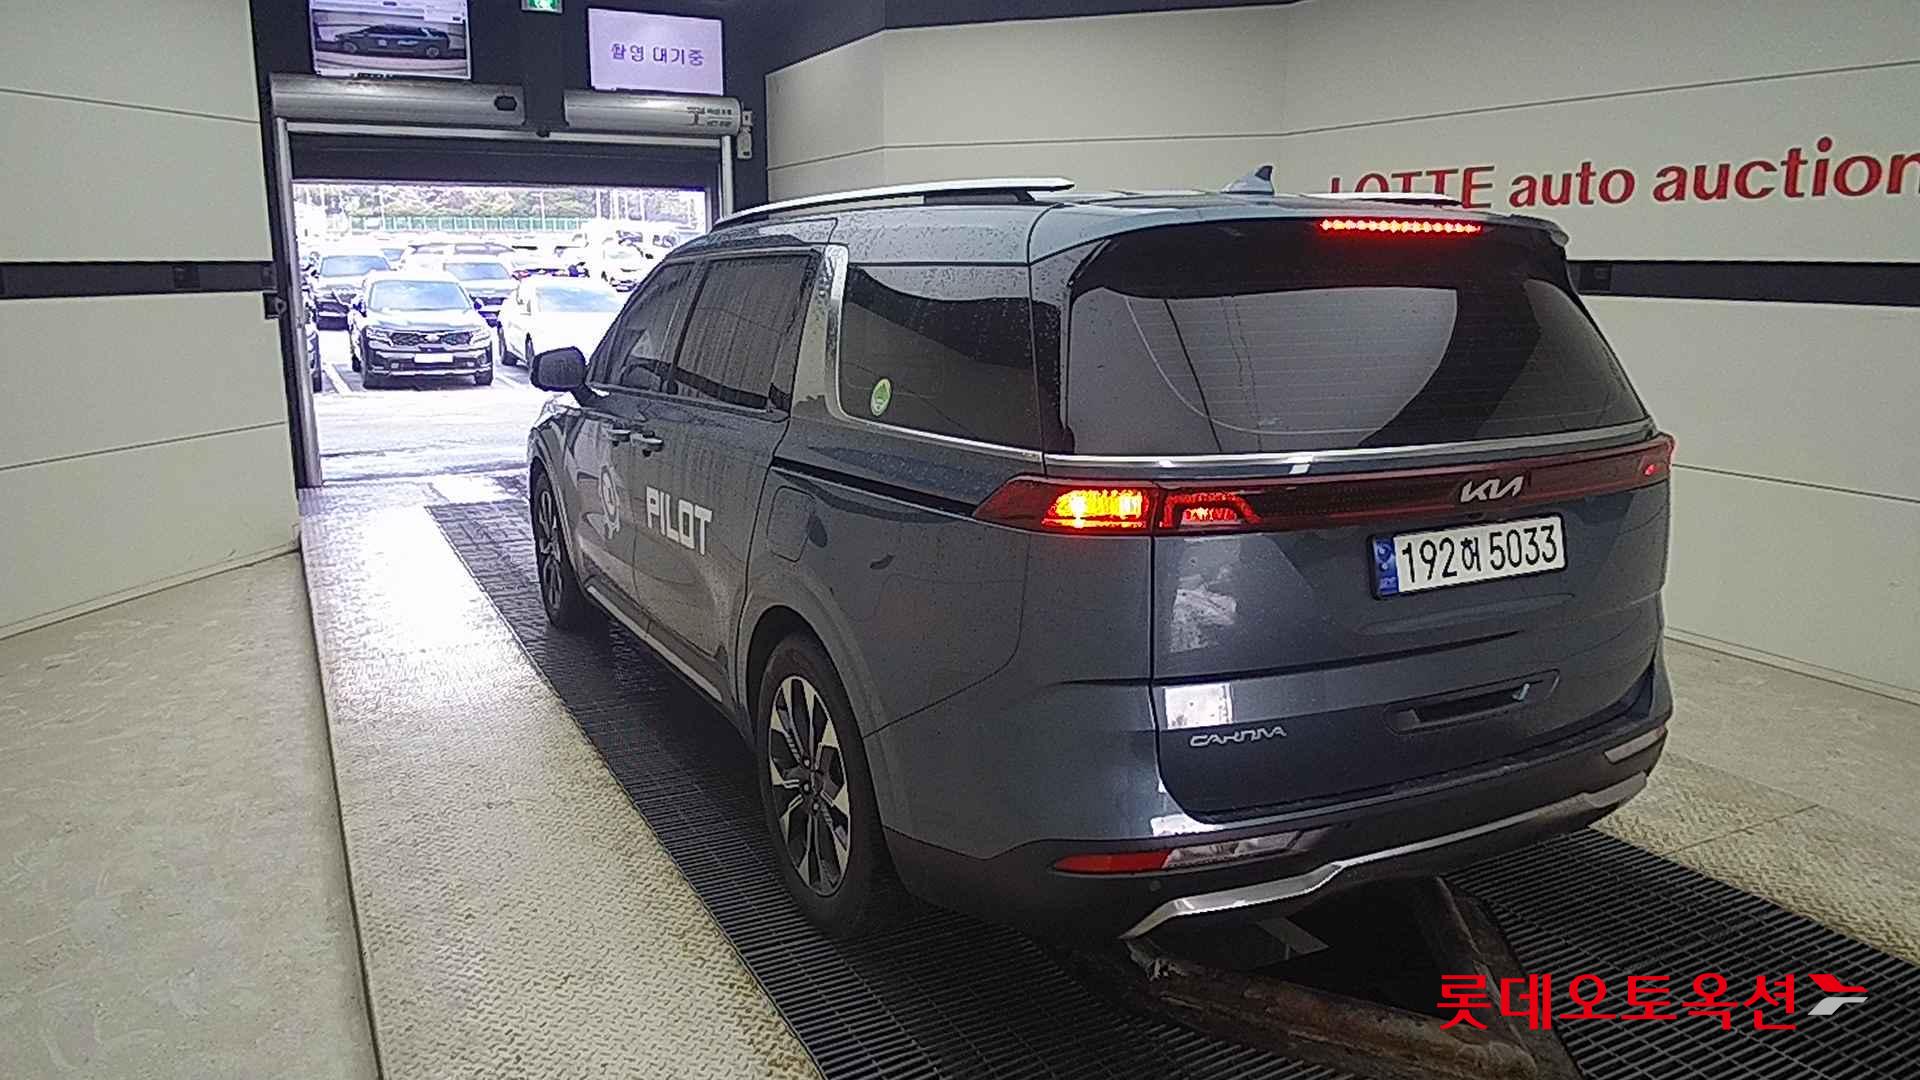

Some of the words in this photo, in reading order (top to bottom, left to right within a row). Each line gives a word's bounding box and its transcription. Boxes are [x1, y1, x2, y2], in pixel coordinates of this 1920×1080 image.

[611, 43, 644, 62] 촬영
[653, 46, 704, 66] 대기중
[1509, 161, 1636, 207] auto
[1652, 136, 1920, 202] auction
[1460, 476, 1525, 503] KIA
[646, 486, 713, 556] PILOT
[1402, 536, 1482, 584] 192허
[1489, 525, 1558, 572] 5033
